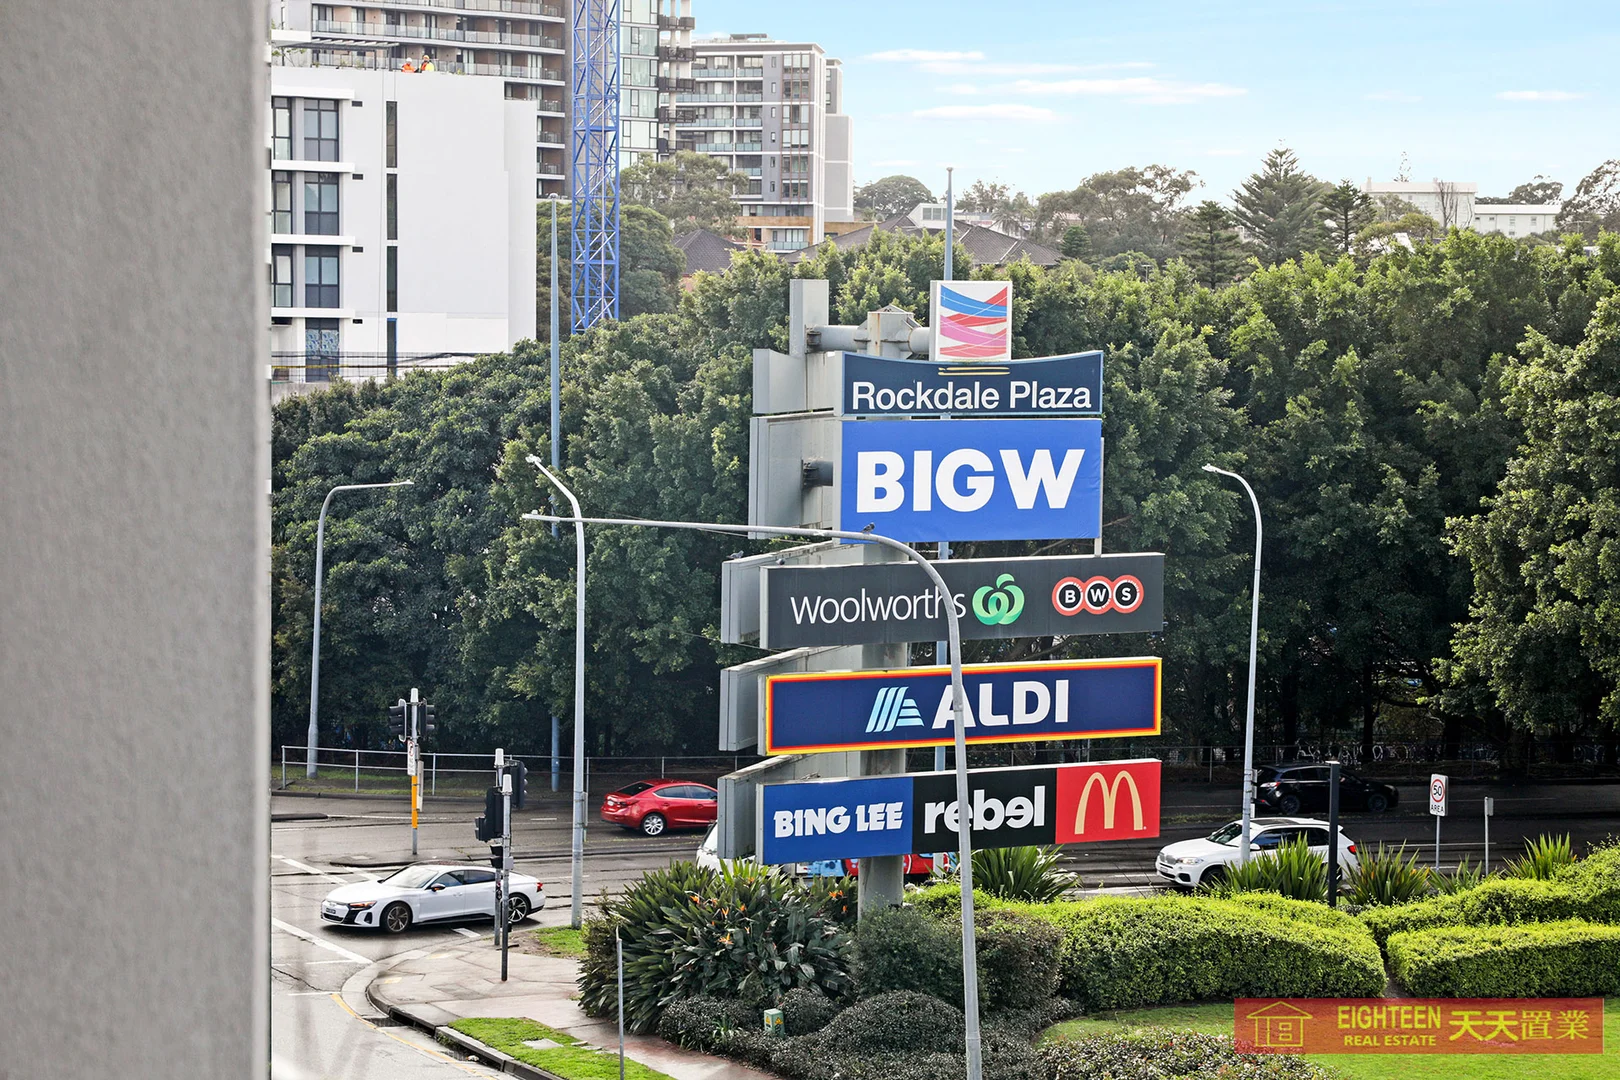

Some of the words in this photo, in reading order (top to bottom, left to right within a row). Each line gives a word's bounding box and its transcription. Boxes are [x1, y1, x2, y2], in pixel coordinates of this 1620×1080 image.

[852, 381, 1000, 410] Rockdale
[1009, 380, 1092, 409] Plaza
[790, 588, 966, 624] Woolworths
[1065, 587, 1132, 604] BWS
[931, 679, 1069, 729] ALDI
[1433, 785, 1442, 796] 50
[773, 804, 851, 838] BING
[856, 801, 904, 832] LEE
[924, 785, 1046, 834] rebel
[1431, 804, 1443, 812] AREA
